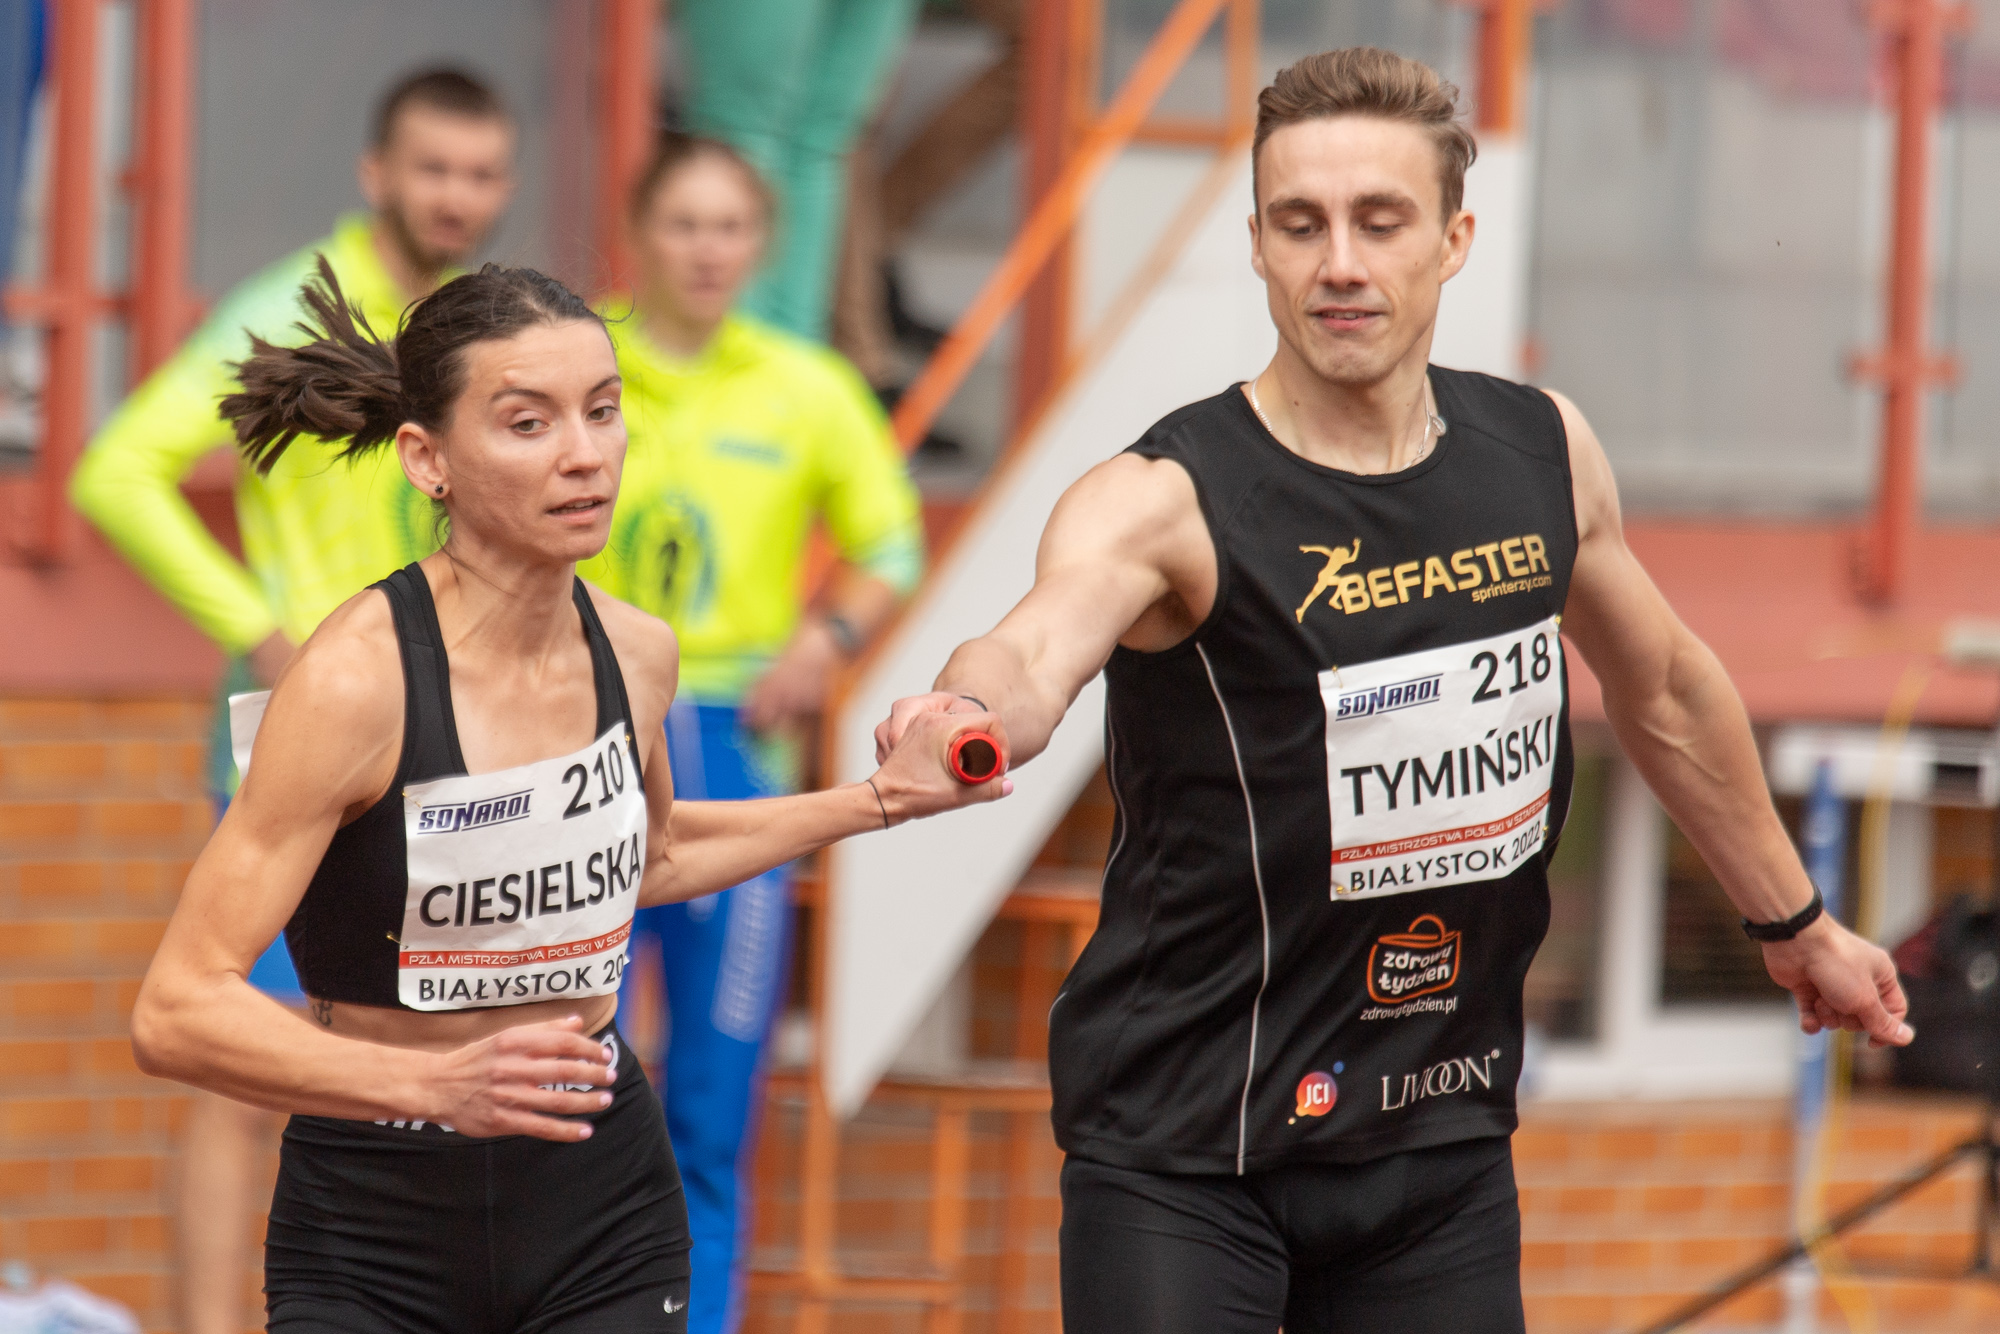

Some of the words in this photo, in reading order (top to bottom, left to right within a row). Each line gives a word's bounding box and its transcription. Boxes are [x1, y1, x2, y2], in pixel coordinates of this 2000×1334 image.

[1338, 534, 1550, 614] BEFASTER
[1471, 574, 1551, 603] sprinterzy.com
[1470, 633, 1551, 704] 218
[1337, 677, 1441, 716] SONAROL
[561, 741, 624, 821] 210
[1340, 715, 1553, 817] TYMIŃSKI
[417, 792, 532, 833] SONAROL
[1340, 847, 1373, 860] PZLA
[1375, 831, 1462, 855] MISTRZOSTWA
[1464, 821, 1504, 839] POLSKI
[1505, 817, 1513, 829] W
[1350, 844, 1507, 893] BIAŁYSTOK
[1512, 820, 1540, 862] 2022
[419, 832, 641, 928] CIESIELSKA
[408, 954, 445, 965] PZLA
[448, 950, 545, 965] MISTRZOSTWA
[548, 943, 592, 959] POLSKI
[594, 939, 605, 950] W
[1382, 944, 1454, 970] zdrowy
[419, 966, 592, 1002] BIAŁYSTOK
[602, 953, 624, 986] 20
[1360, 996, 1458, 1020] zdrowytydzien.pl
[1304, 1083, 1330, 1108] JCI
